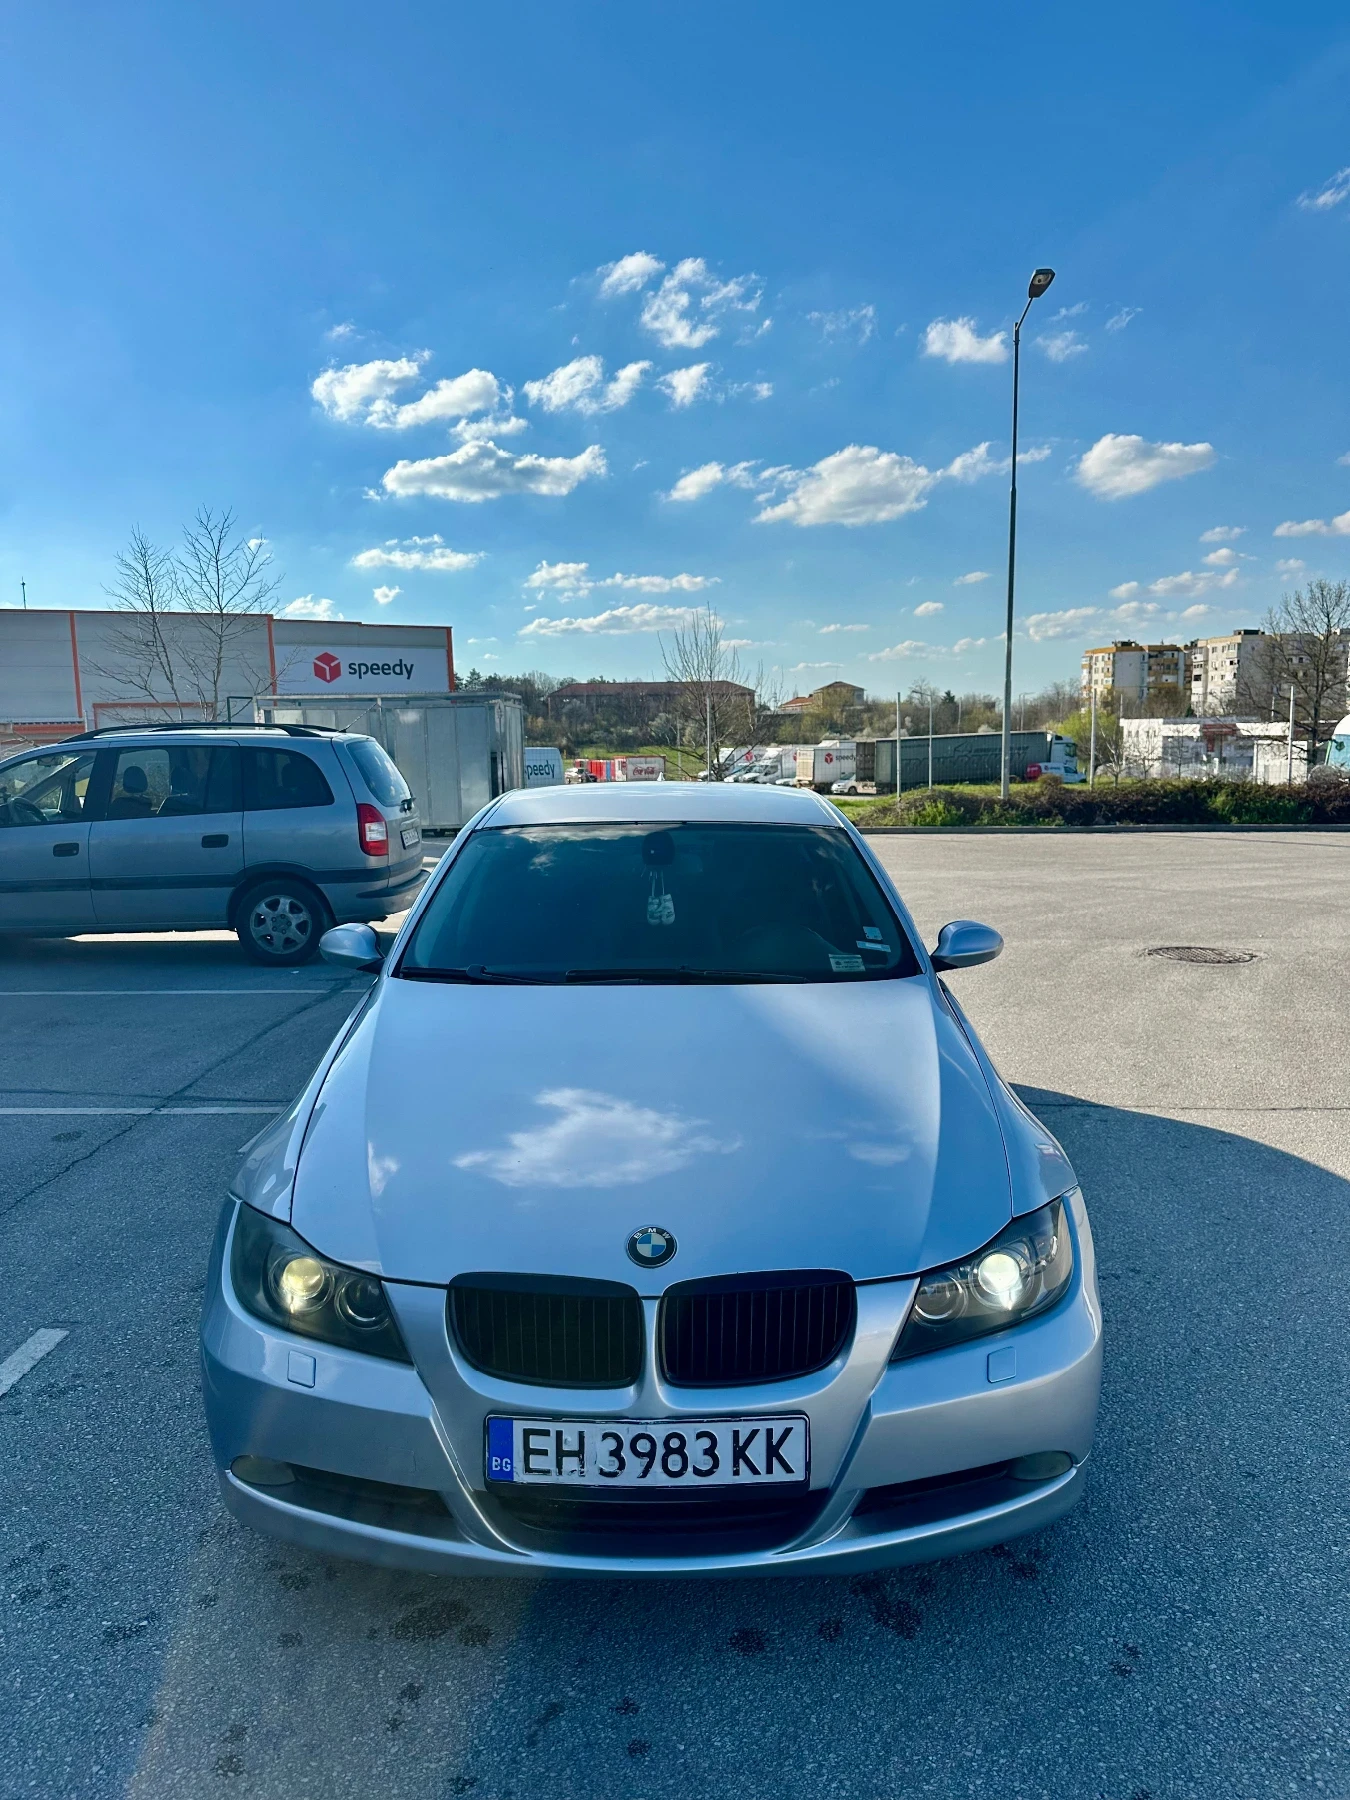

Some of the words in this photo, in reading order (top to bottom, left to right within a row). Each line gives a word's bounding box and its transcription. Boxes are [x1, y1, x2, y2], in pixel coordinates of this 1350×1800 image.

[348, 658, 414, 680] speedy
[525, 759, 555, 780] peedy
[633, 1227, 672, 1239] BMW
[491, 1456, 512, 1472] BG
[522, 1428, 586, 1477] EH
[598, 1430, 720, 1479] 3983
[732, 1426, 795, 1477] KK
